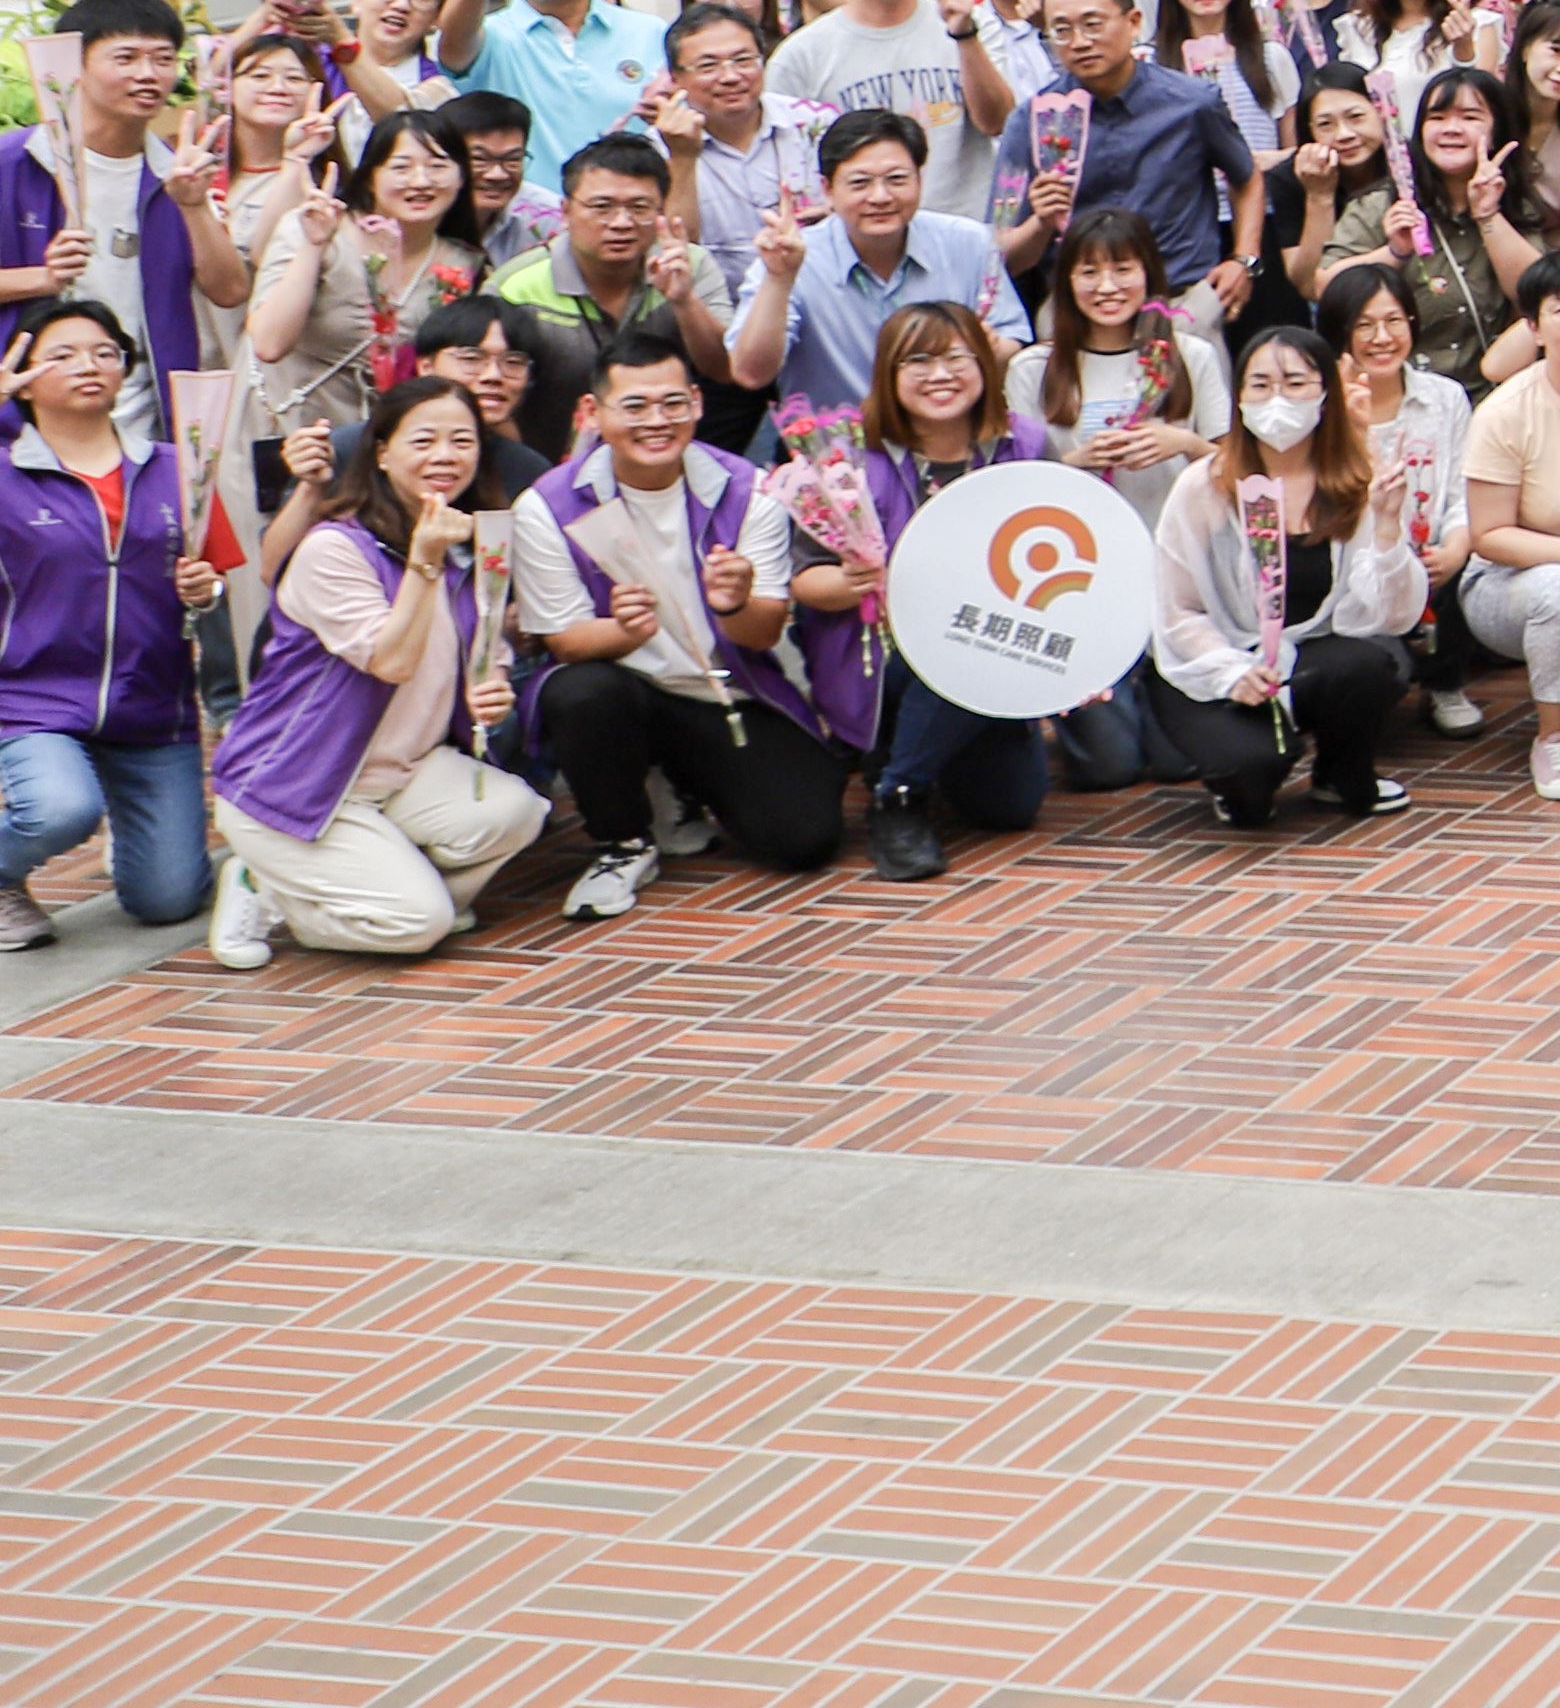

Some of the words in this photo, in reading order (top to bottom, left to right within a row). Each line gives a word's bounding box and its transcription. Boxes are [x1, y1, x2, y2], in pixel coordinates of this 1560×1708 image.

[839, 73, 893, 111] NEW
[900, 68, 963, 105] YORK
[950, 603, 1077, 662] 長期照顧
